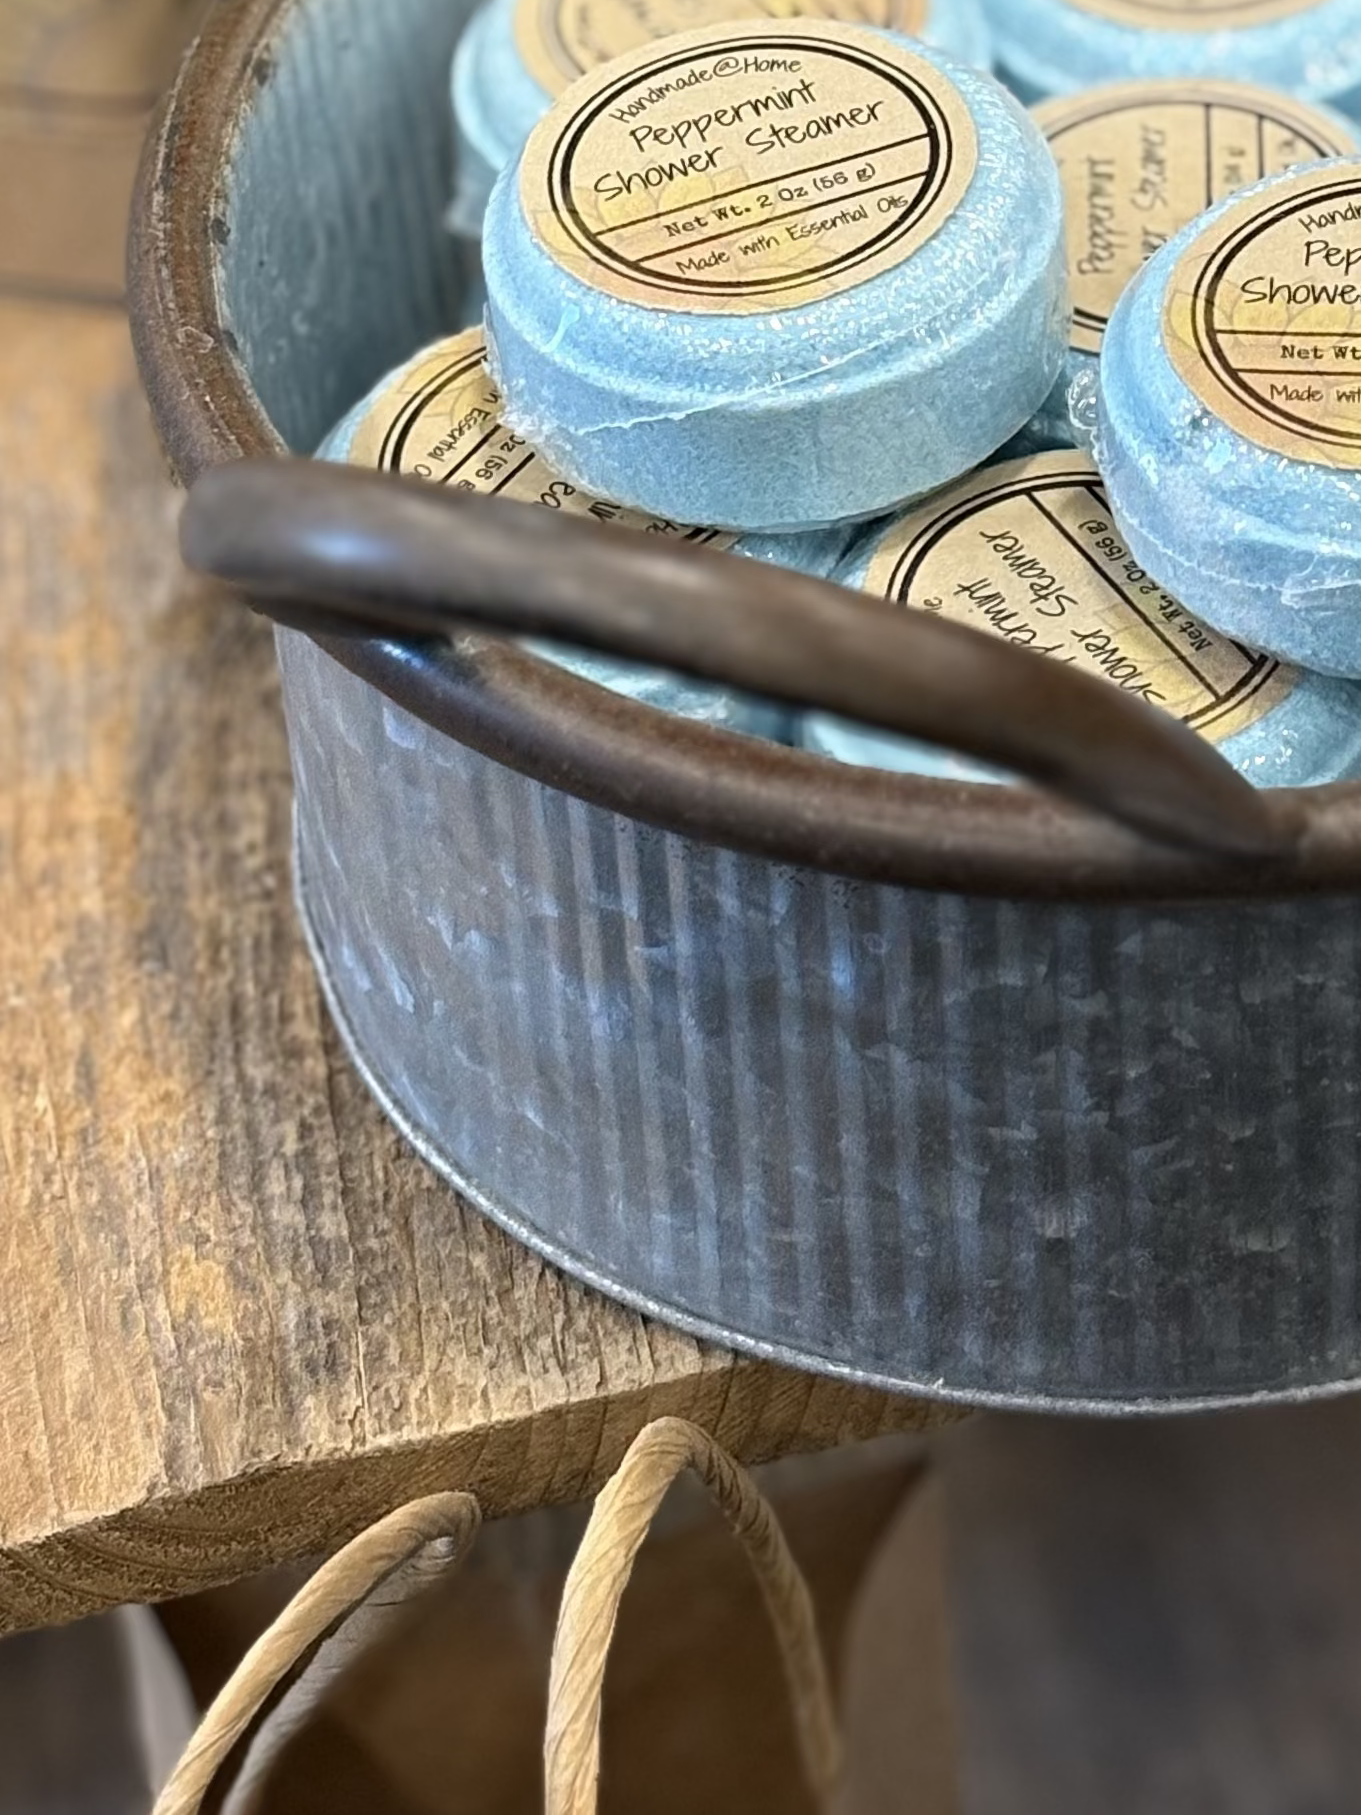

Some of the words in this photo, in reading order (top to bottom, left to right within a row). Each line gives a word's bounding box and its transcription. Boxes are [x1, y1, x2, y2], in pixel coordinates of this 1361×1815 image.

[609, 56, 801, 123] Handmade@Home
[629, 78, 815, 151] Peppermint
[594, 147, 722, 201] Shower
[746, 100, 884, 155] Steamer
[666, 216, 708, 237] Net
[713, 199, 752, 222] Wt.
[756, 194, 774, 208] 2
[778, 185, 808, 201] Oz
[813, 171, 848, 194] (56
[857, 162, 877, 183] g)
[675, 252, 730, 275] Made
[739, 233, 780, 257] with
[787, 206, 869, 241] Essential
[1280, 345, 1324, 361] Net
[1270, 384, 1324, 403] Made
[428, 407, 490, 462] Essential
[1078, 519, 1107, 539] g)
[1096, 535, 1128, 565] (56
[979, 528, 1079, 617] Steamer
[1122, 561, 1148, 584] Oz
[1138, 581, 1156, 597] 2
[1179, 618, 1214, 652] Net
